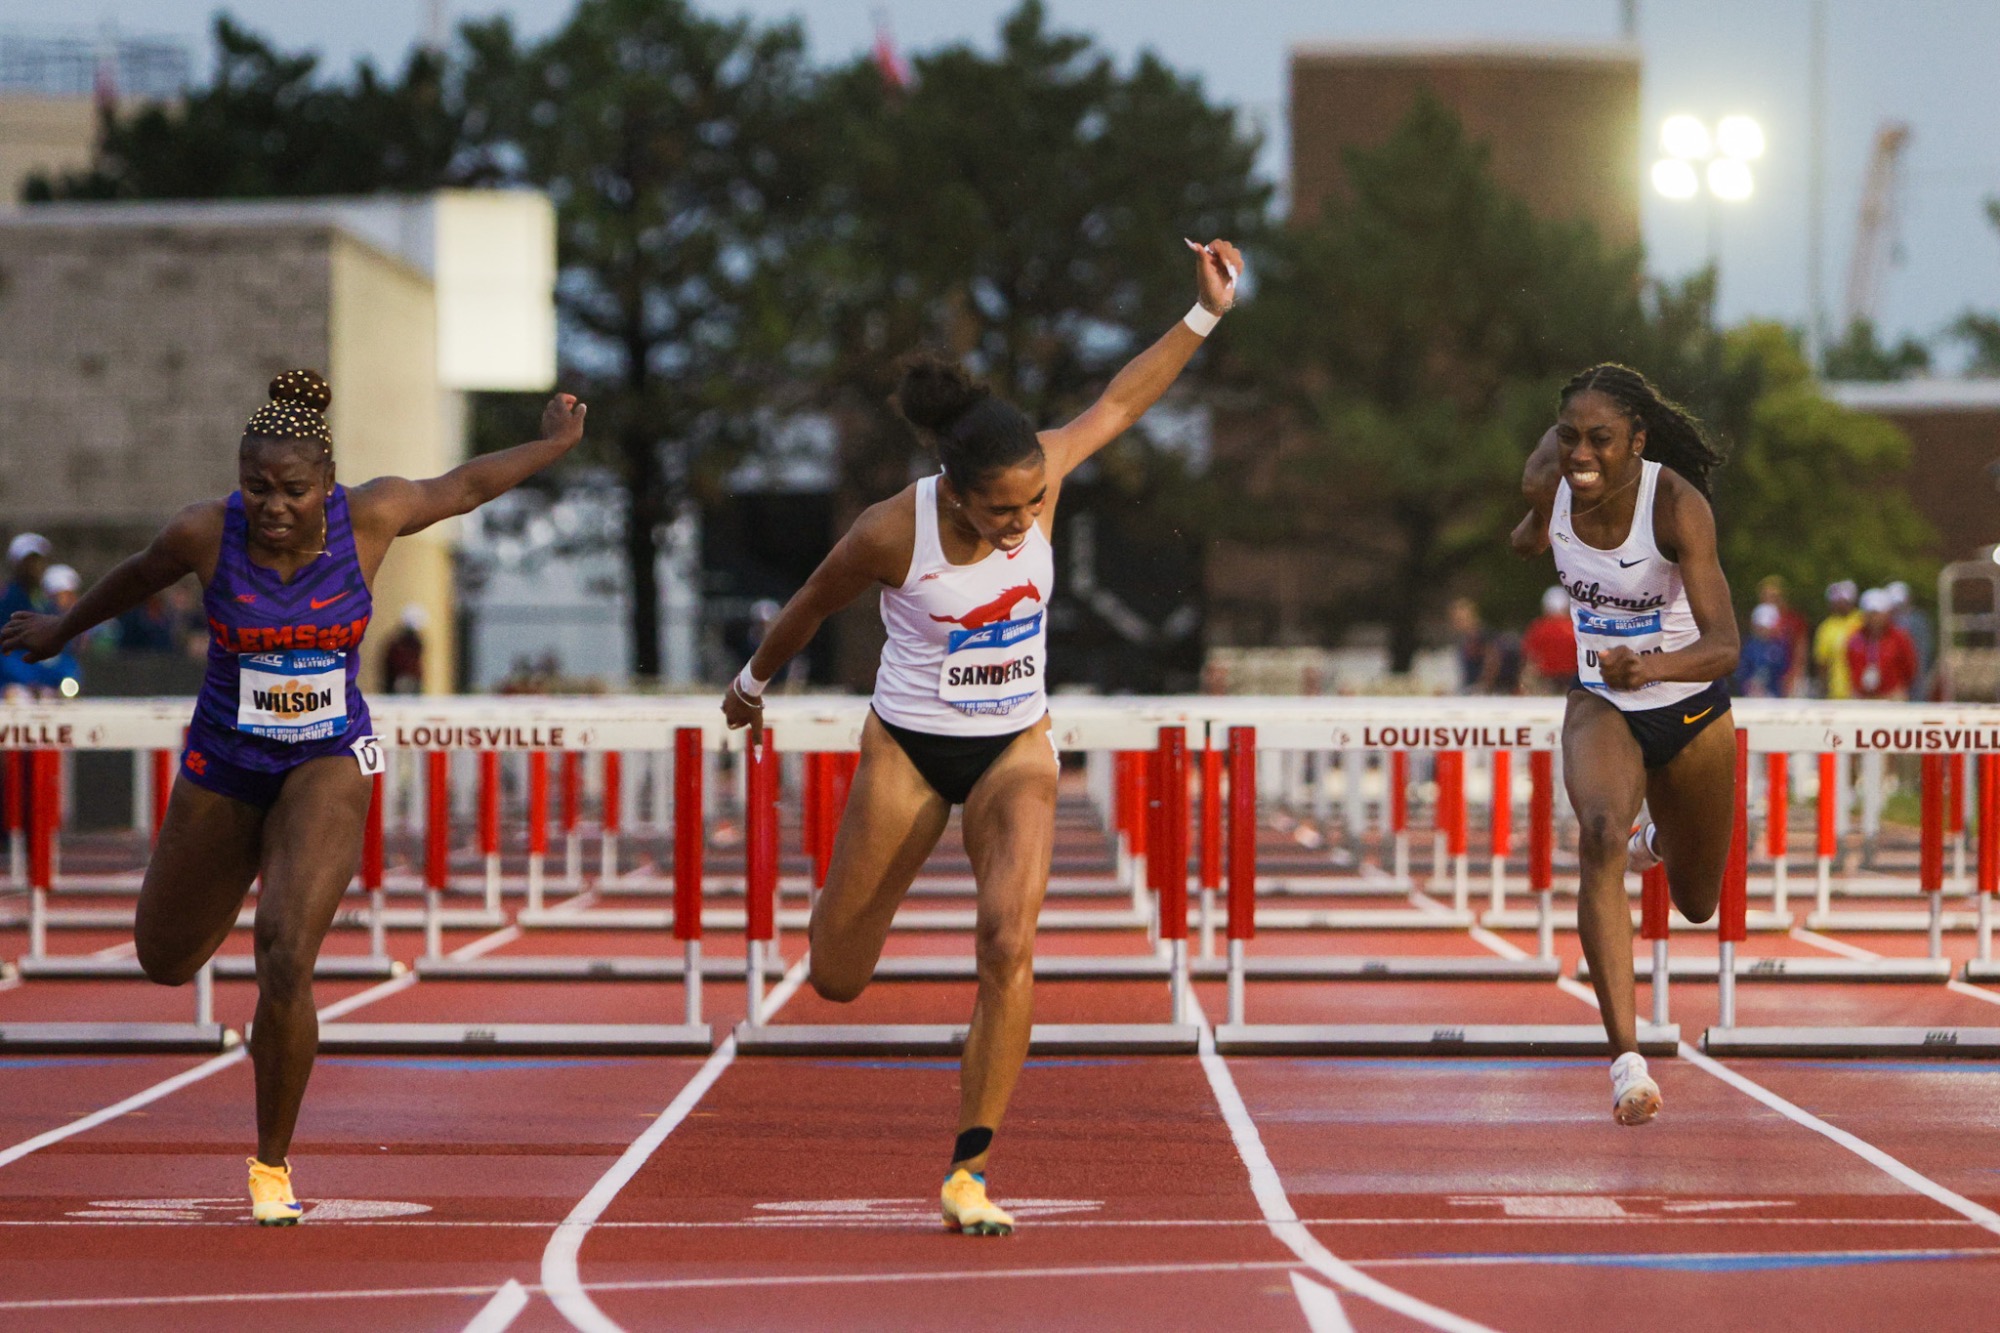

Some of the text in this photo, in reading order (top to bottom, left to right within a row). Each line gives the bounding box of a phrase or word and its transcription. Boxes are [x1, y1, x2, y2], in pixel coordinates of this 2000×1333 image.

[1585, 616, 1608, 629] ACC
[957, 630, 994, 648] ACC
[249, 654, 284, 667] ACC
[948, 655, 1035, 686] SANDERS
[253, 688, 331, 713] WILSON
[396, 727, 564, 746] LOUISVILLE
[1363, 727, 1532, 746] LOUISVILLE
